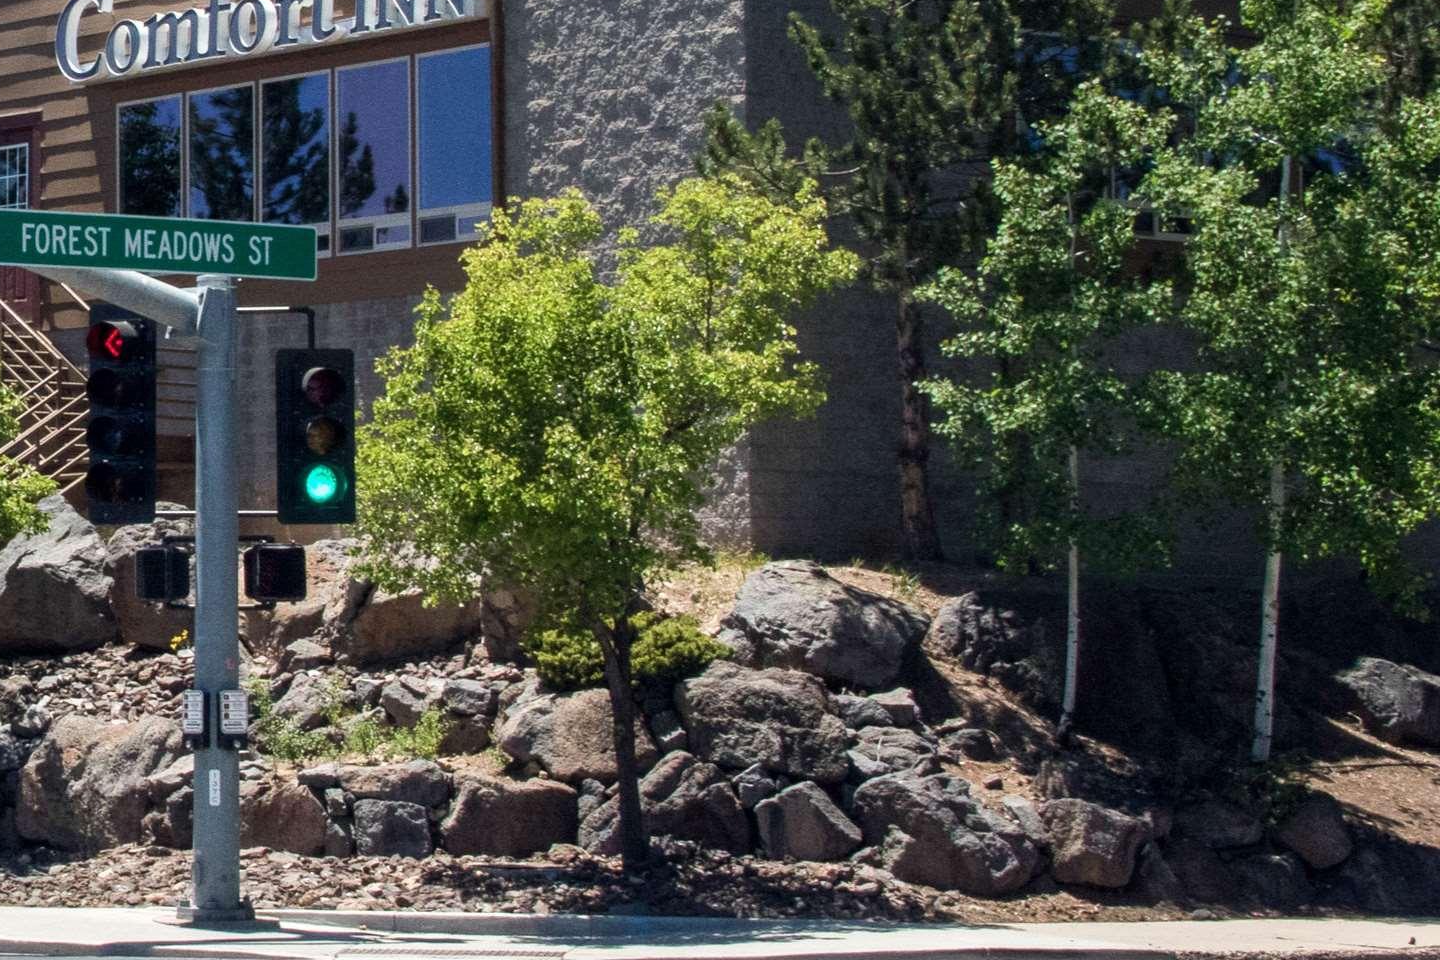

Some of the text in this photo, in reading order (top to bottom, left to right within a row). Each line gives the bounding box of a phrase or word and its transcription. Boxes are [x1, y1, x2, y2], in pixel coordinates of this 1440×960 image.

[21, 222, 274, 266] FOREST MEADOWS ST
